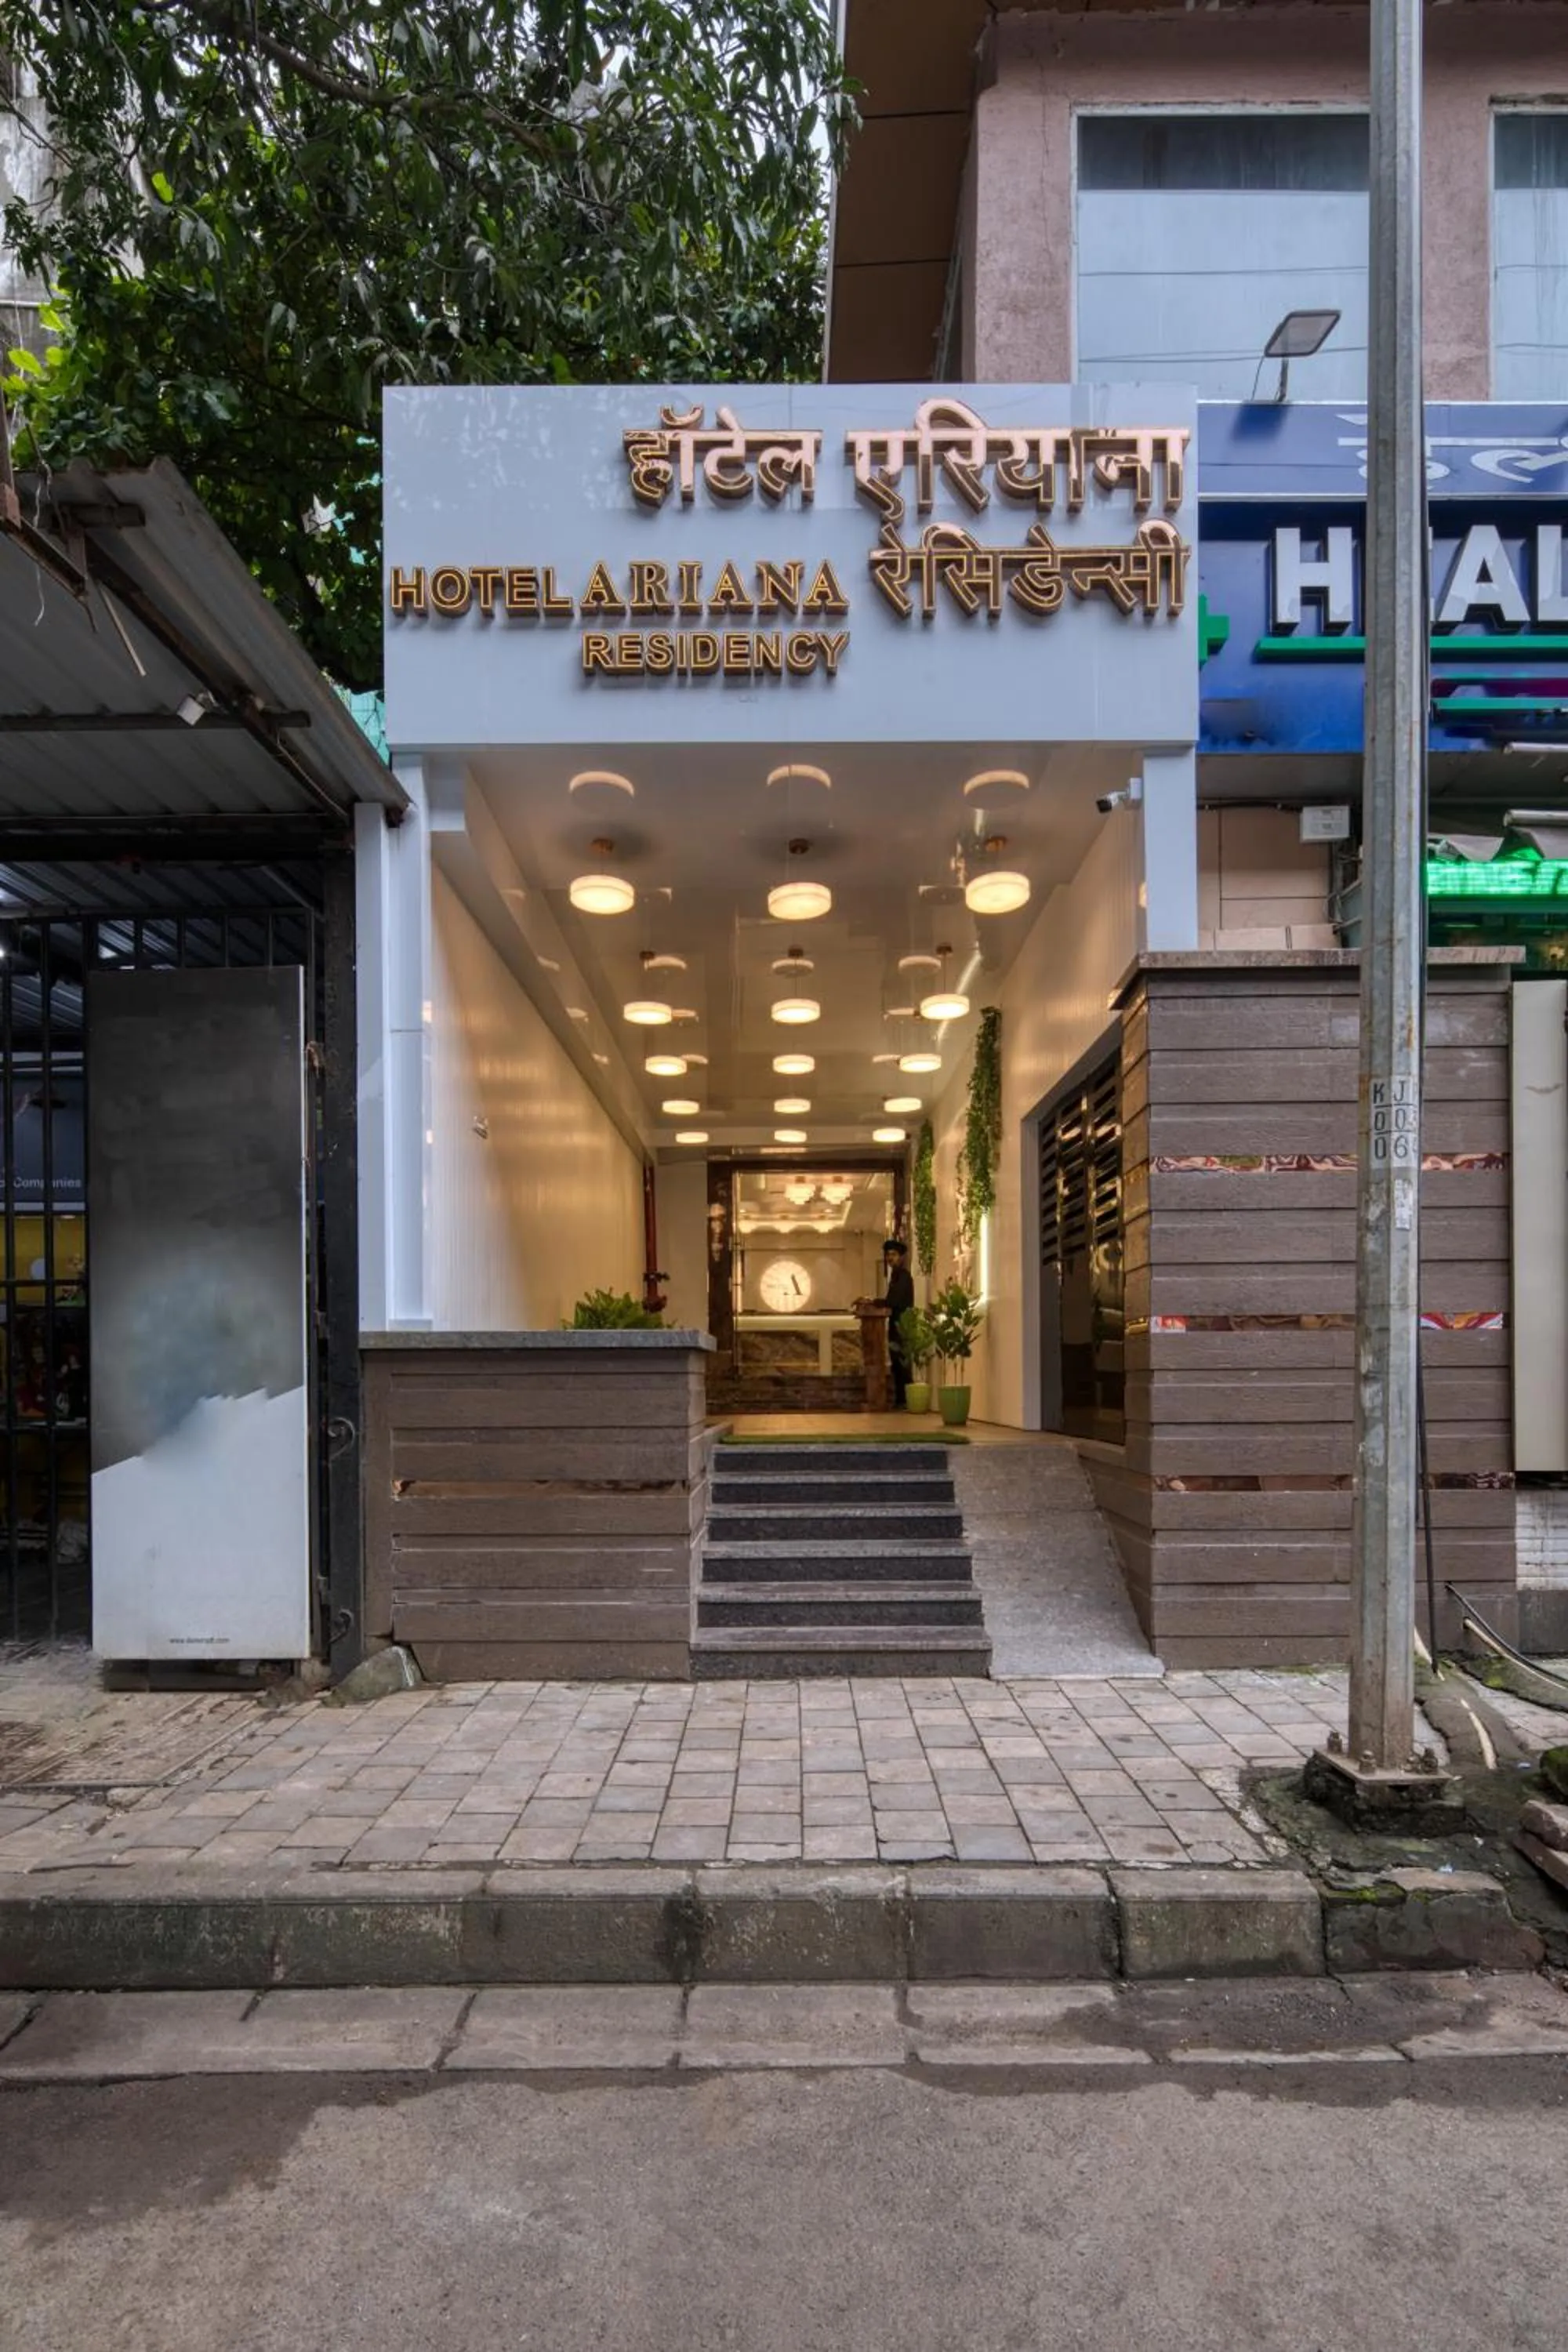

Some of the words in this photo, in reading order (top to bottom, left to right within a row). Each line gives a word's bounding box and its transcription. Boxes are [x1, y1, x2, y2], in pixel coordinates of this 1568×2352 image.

[622, 405, 822, 508] हॉटेल
[845, 397, 1190, 524] एरियाना
[390, 564, 575, 618] HOTEL
[579, 558, 850, 617] ARIANA
[869, 518, 1191, 618] रेसिडेन्सी
[1273, 524, 1568, 632] HAL
[583, 631, 851, 676] RESIDENCY
